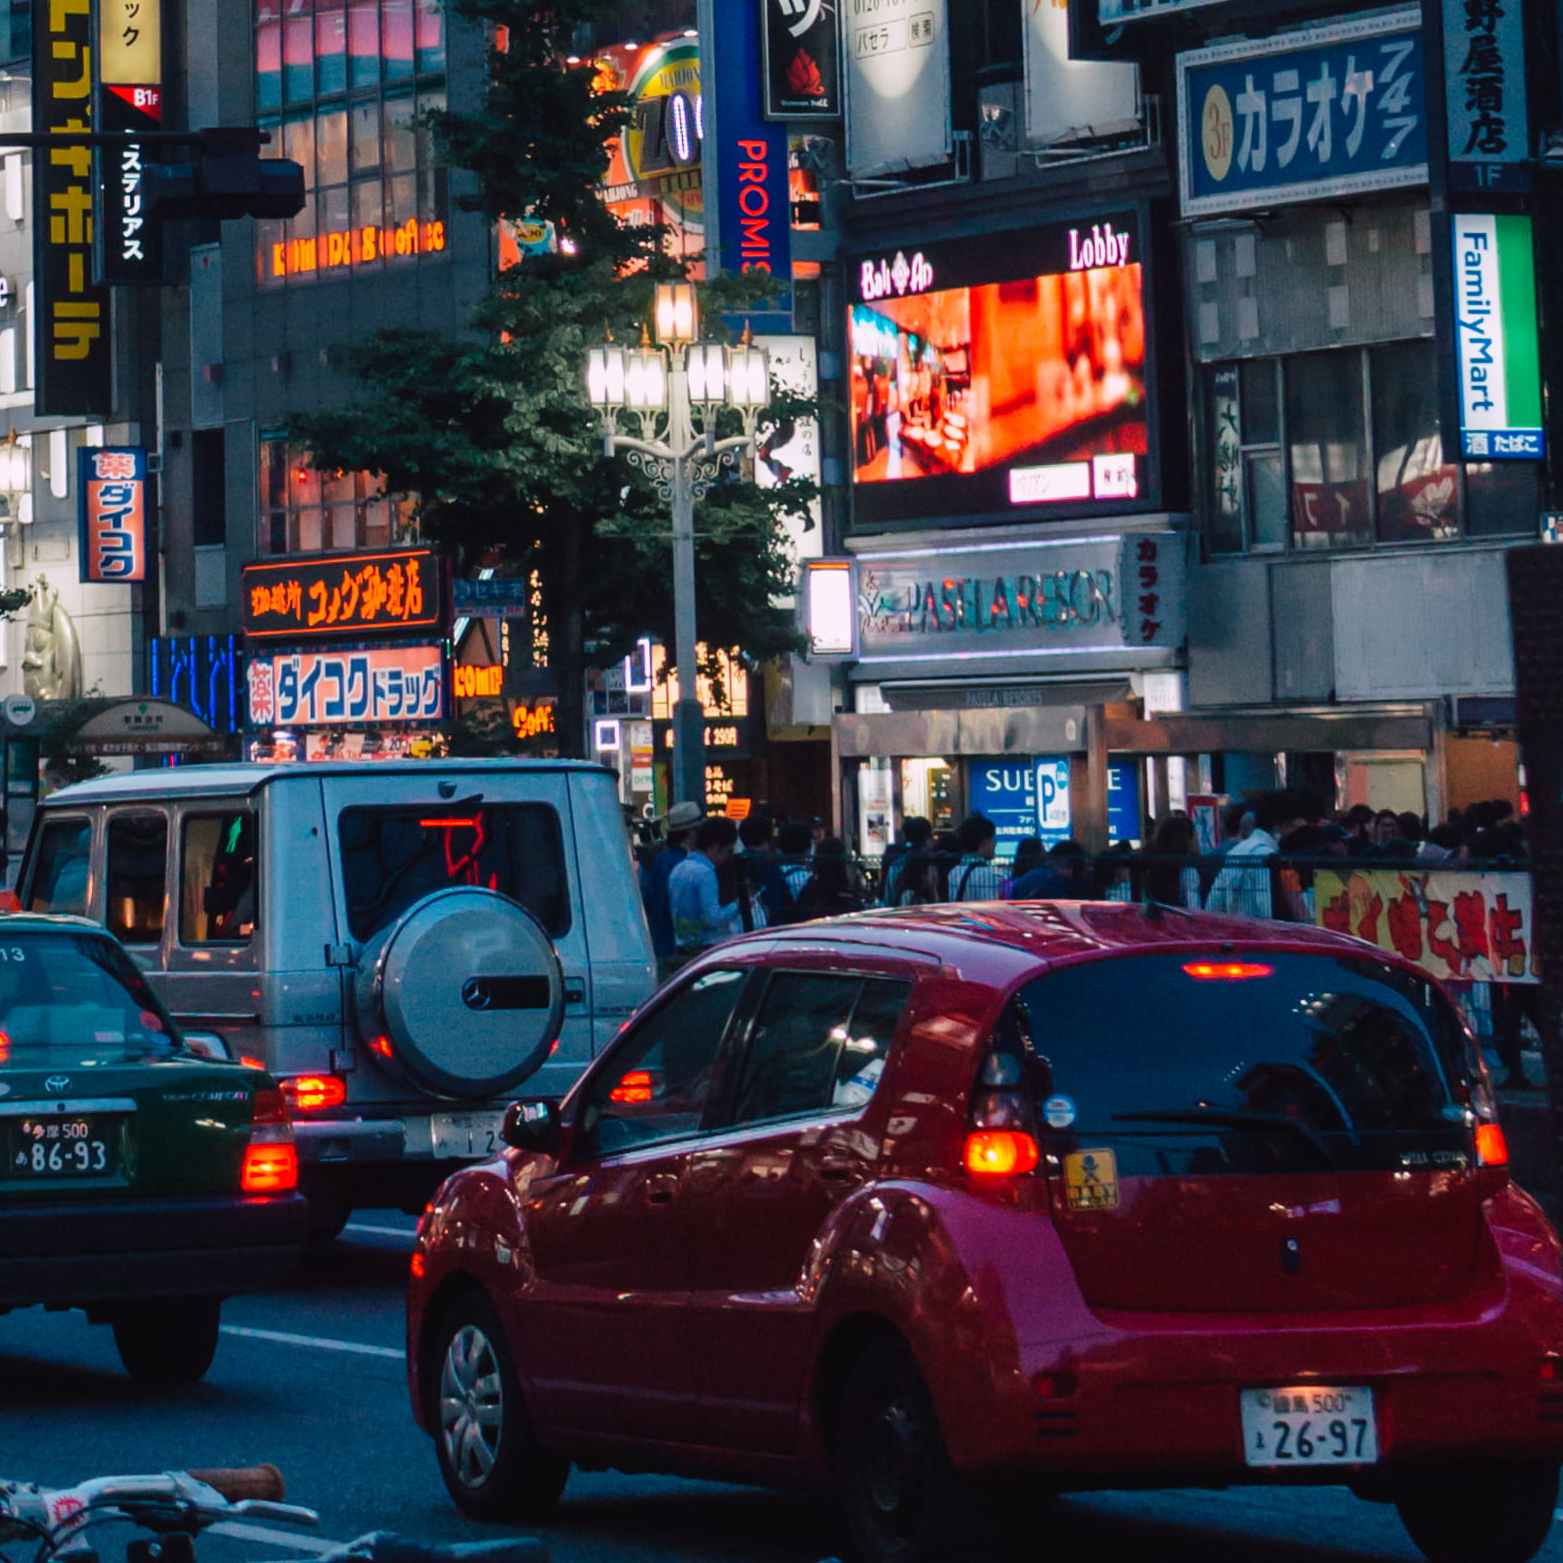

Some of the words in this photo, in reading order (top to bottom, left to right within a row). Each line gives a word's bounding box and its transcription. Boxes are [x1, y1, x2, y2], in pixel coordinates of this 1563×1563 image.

[134, 89, 158, 106] B1F
[1236, 56, 1374, 172] カラオケ
[1376, 42, 1418, 159] 747
[1209, 106, 1232, 160] 3F
[1474, 165, 1501, 186] 1F
[738, 140, 772, 275] PROMIS
[1068, 223, 1130, 271] Lobby
[1458, 231, 1496, 412] FamilyMart
[93, 452, 135, 477] 薬
[1465, 433, 1487, 455] 酒
[1494, 434, 1538, 454] たばこ
[99, 483, 135, 579] ダイコク
[251, 580, 302, 620] 珈琲所
[308, 558, 423, 626] コメダ珈琲店
[905, 575, 1011, 633] PASELA
[1016, 569, 1118, 626] RESOR
[1137, 537, 1160, 642] カラオケ
[248, 661, 274, 724] 薬
[278, 654, 441, 723] ダイコクドラッグ
[31, 1141, 106, 1171] 86-93
[62, 1123, 88, 1139] 500
[1313, 1394, 1343, 1414] 500
[1274, 1419, 1368, 1460] 26-97
